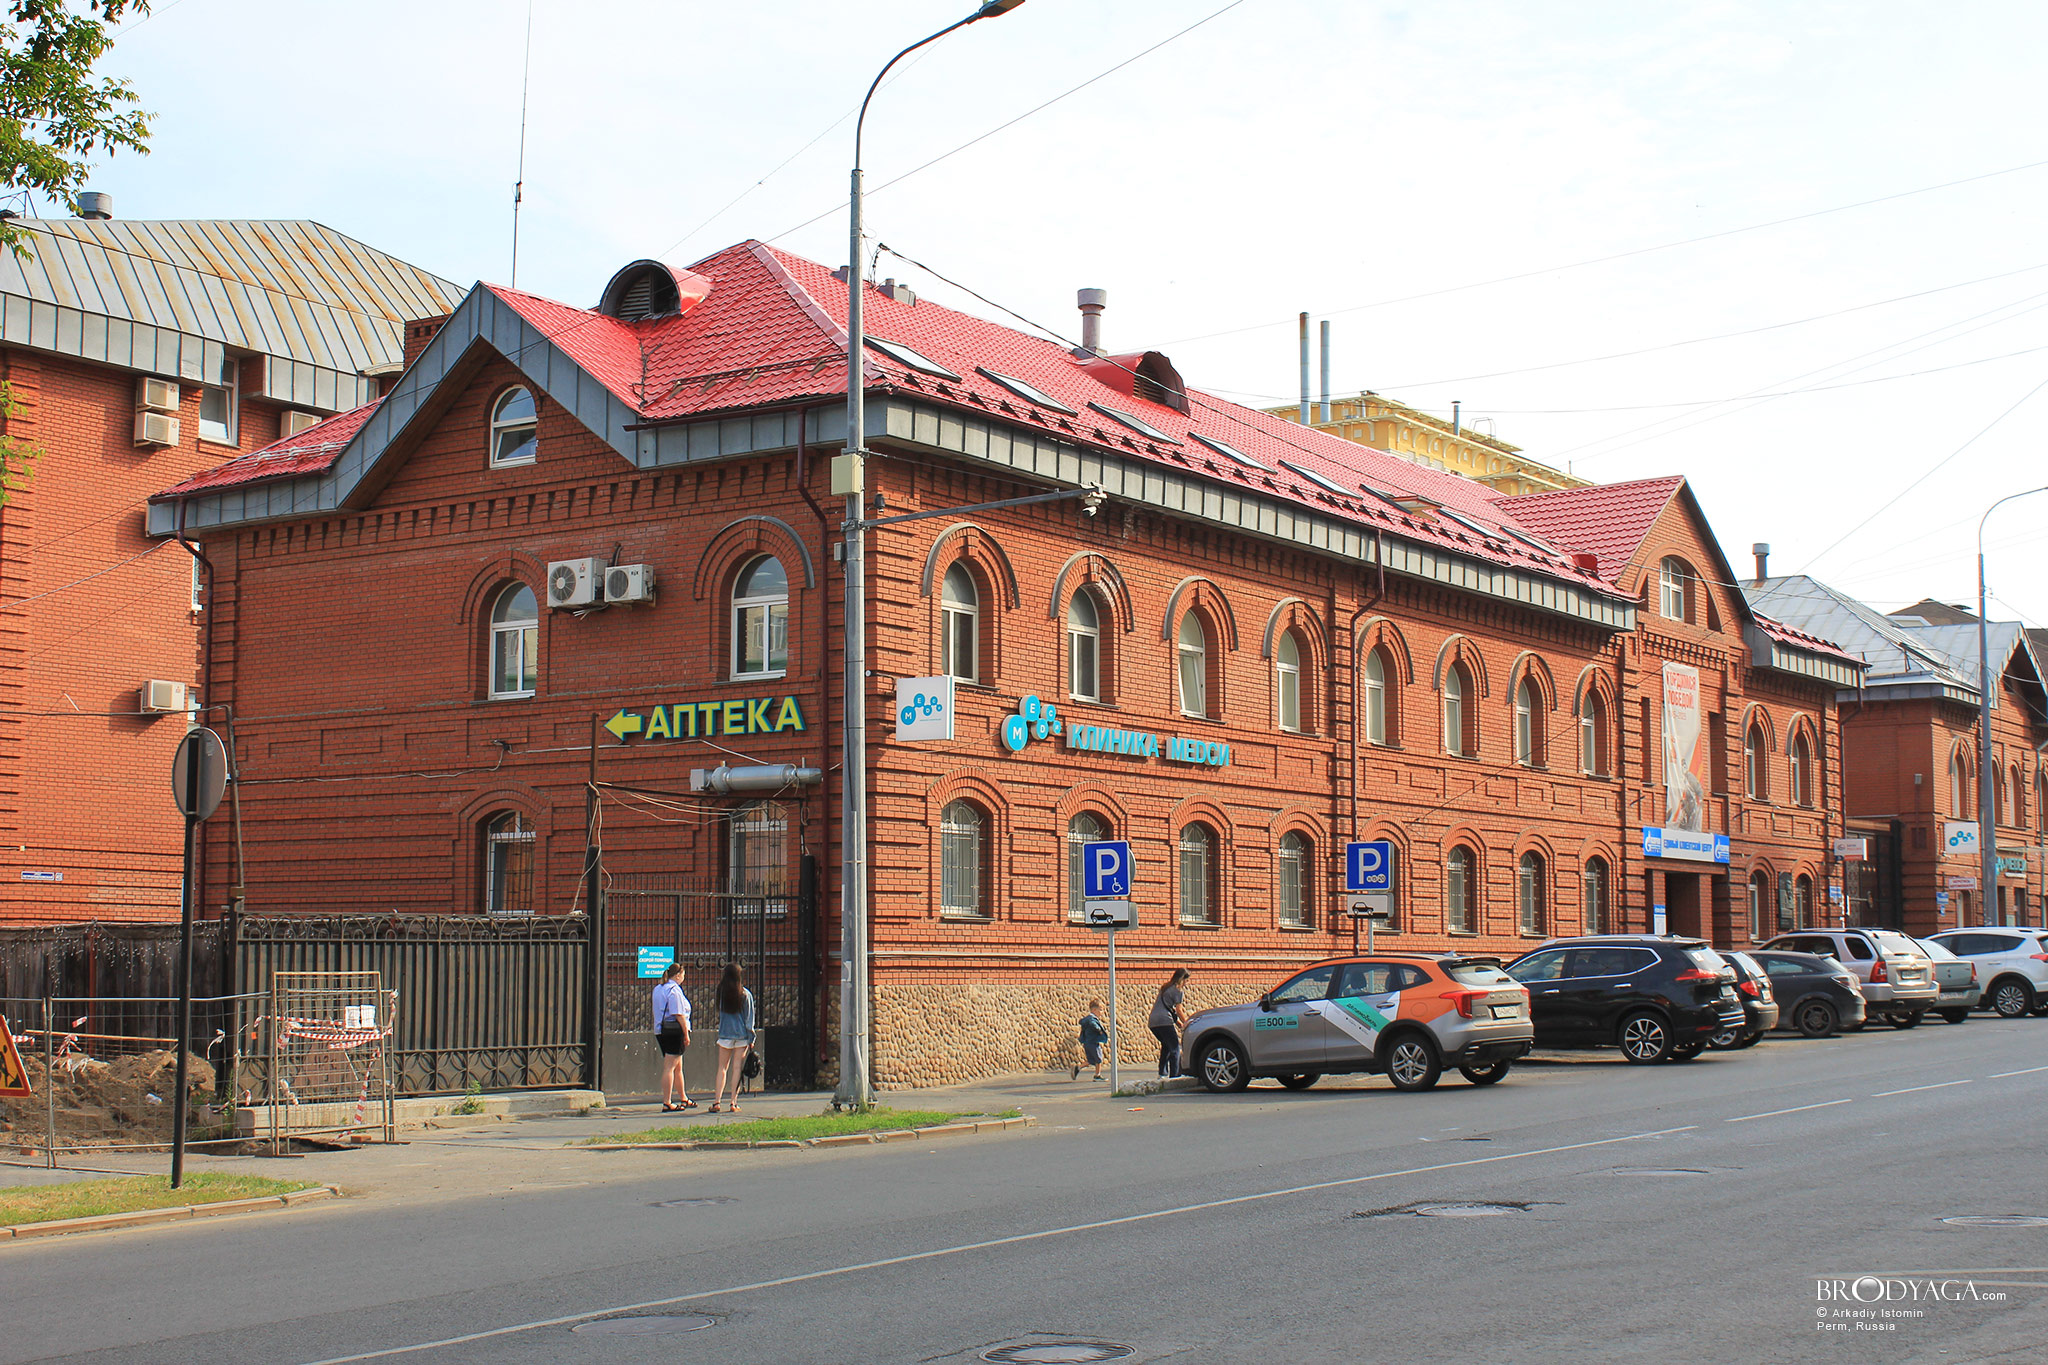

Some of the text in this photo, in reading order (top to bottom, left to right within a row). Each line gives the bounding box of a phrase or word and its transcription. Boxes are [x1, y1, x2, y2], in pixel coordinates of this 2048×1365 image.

[645, 696, 806, 740] АПТЕКА
[1069, 724, 1159, 758] КЛИНИКА
[1096, 849, 1120, 891] P
[1359, 848, 1382, 885] P
[1267, 1017, 1283, 1027] 500
